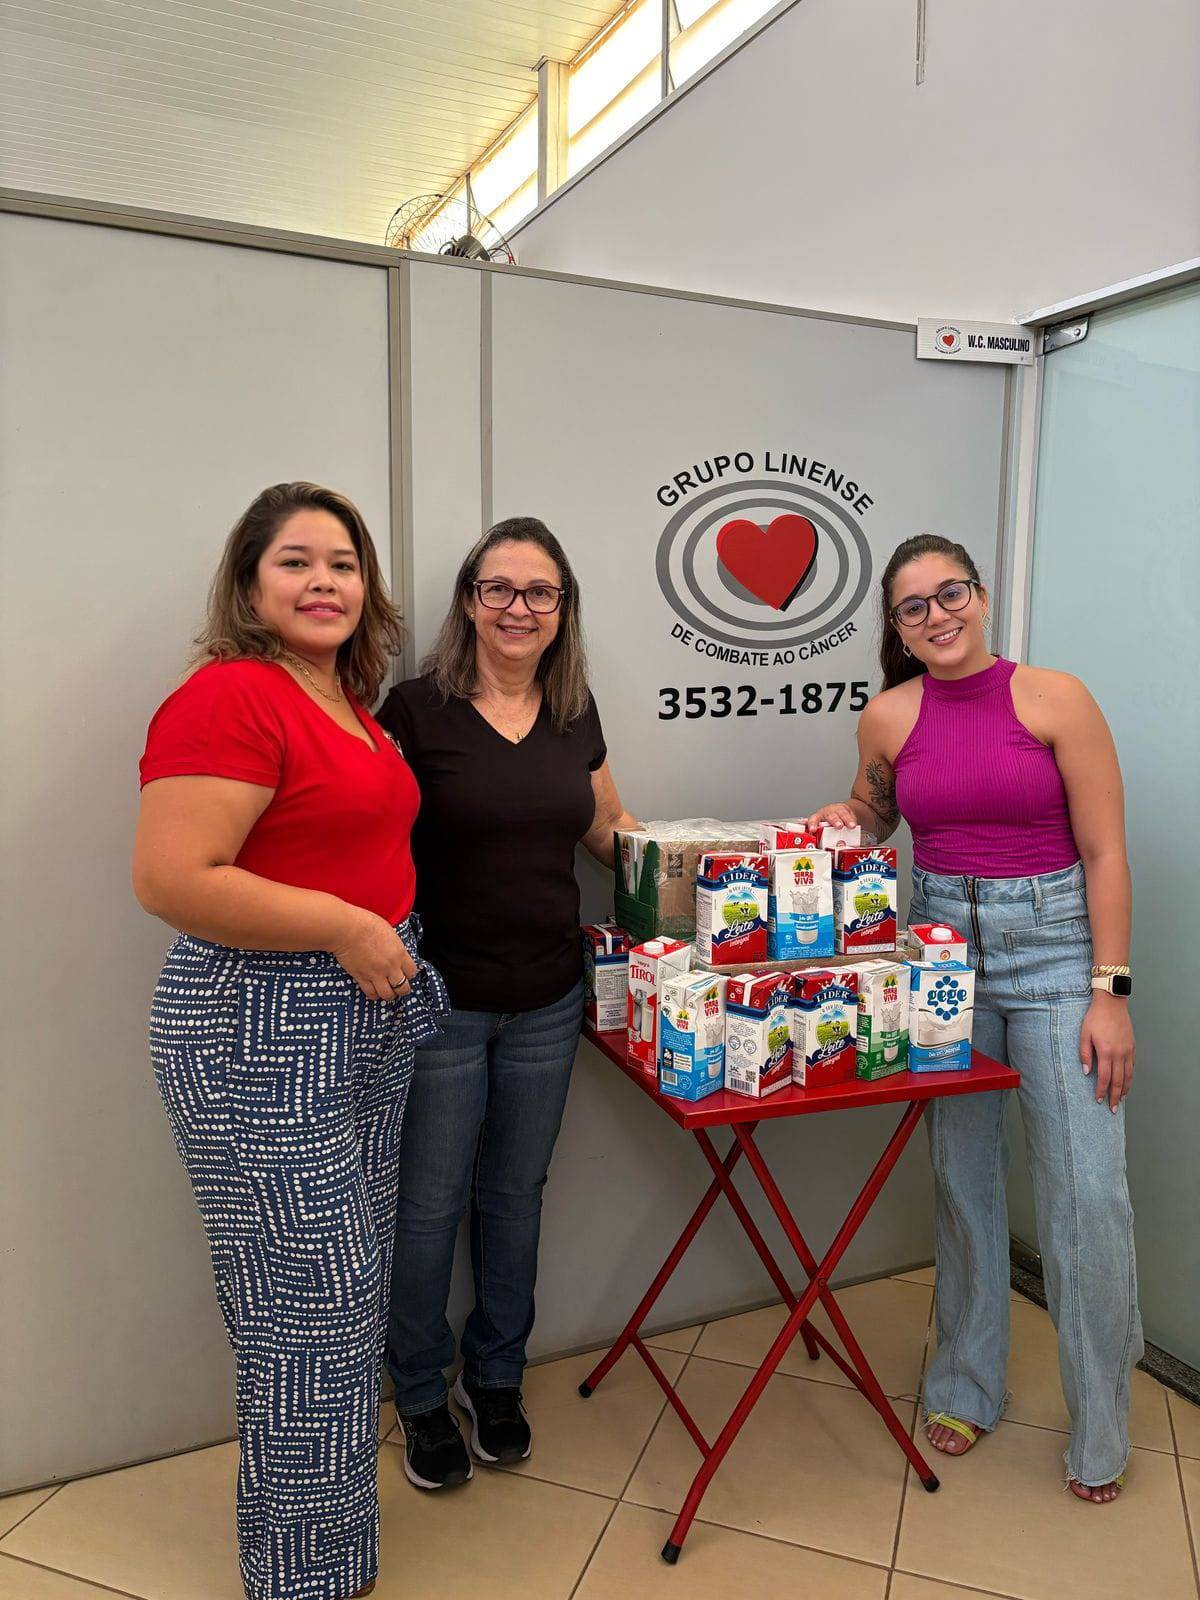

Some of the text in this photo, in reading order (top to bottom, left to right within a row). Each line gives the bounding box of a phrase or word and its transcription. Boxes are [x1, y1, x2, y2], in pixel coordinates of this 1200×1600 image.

[968, 335, 1030, 353] W.C. MASCULINO
[656, 452, 875, 515] GRUPO LINENSE
[670, 621, 858, 666] DE COMBATE AO CÂNCER
[658, 681, 869, 720] 3532-1875
[723, 872, 758, 883] LIDER
[854, 863, 886, 874] LIDER
[724, 919, 754, 939] Leite
[856, 909, 884, 929] Leite
[630, 964, 657, 986] TIROL
[816, 989, 849, 1002] LIDER
[927, 989, 967, 1007] gege
[818, 1039, 845, 1059] Leite
